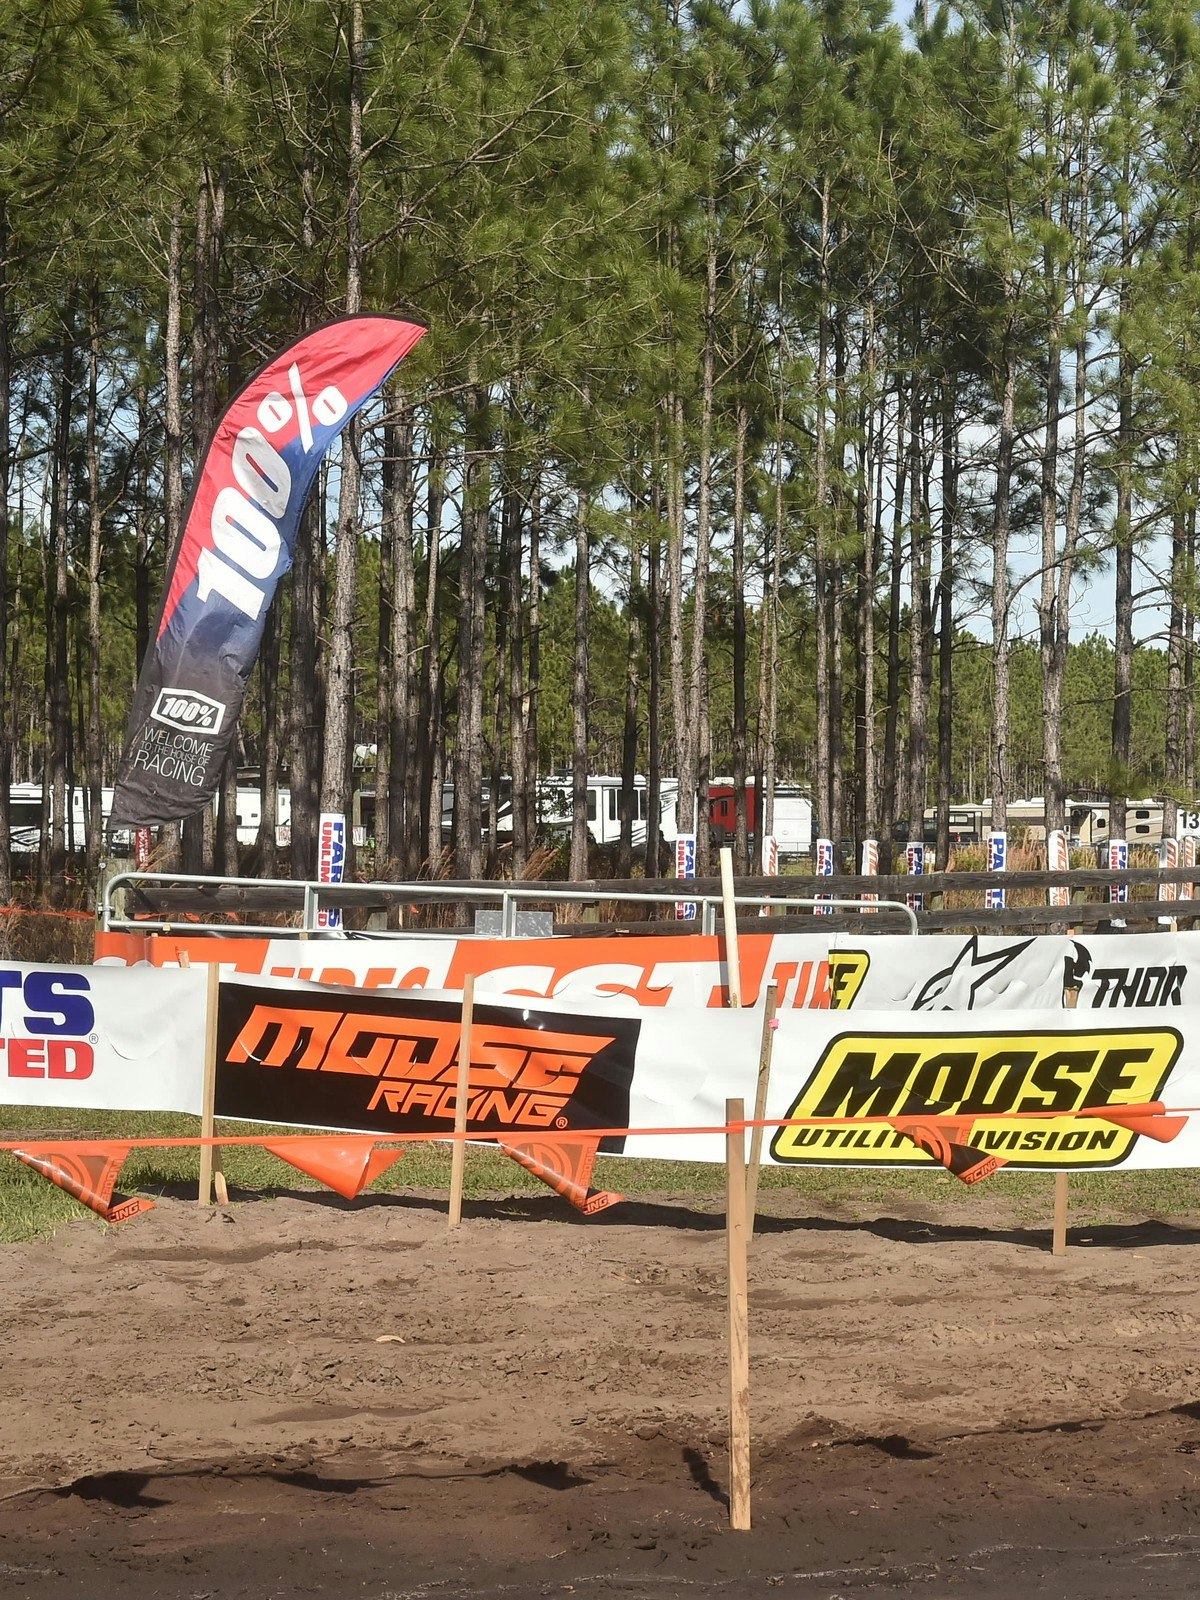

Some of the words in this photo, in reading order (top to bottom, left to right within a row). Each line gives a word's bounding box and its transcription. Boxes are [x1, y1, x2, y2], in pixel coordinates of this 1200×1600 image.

[196, 362, 348, 621] 100%
[162, 697, 216, 727] 100%
[140, 741, 152, 751] TO
[153, 744, 169, 756] THE
[170, 750, 197, 763] HOUSE
[197, 757, 211, 767] OF
[144, 727, 215, 758] WELCOME
[134, 750, 206, 787] RACING
[1179, 811, 1200, 829] 13
[1091, 965, 1188, 1009] THOR
[226, 1005, 616, 1095] MOOSE
[812, 1047, 1156, 1120] MOOSE
[366, 1080, 570, 1127] RACING
[967, 1128, 1119, 1151] IVISION
[963, 1157, 998, 1184] ACING
[107, 1200, 140, 1224] CING
